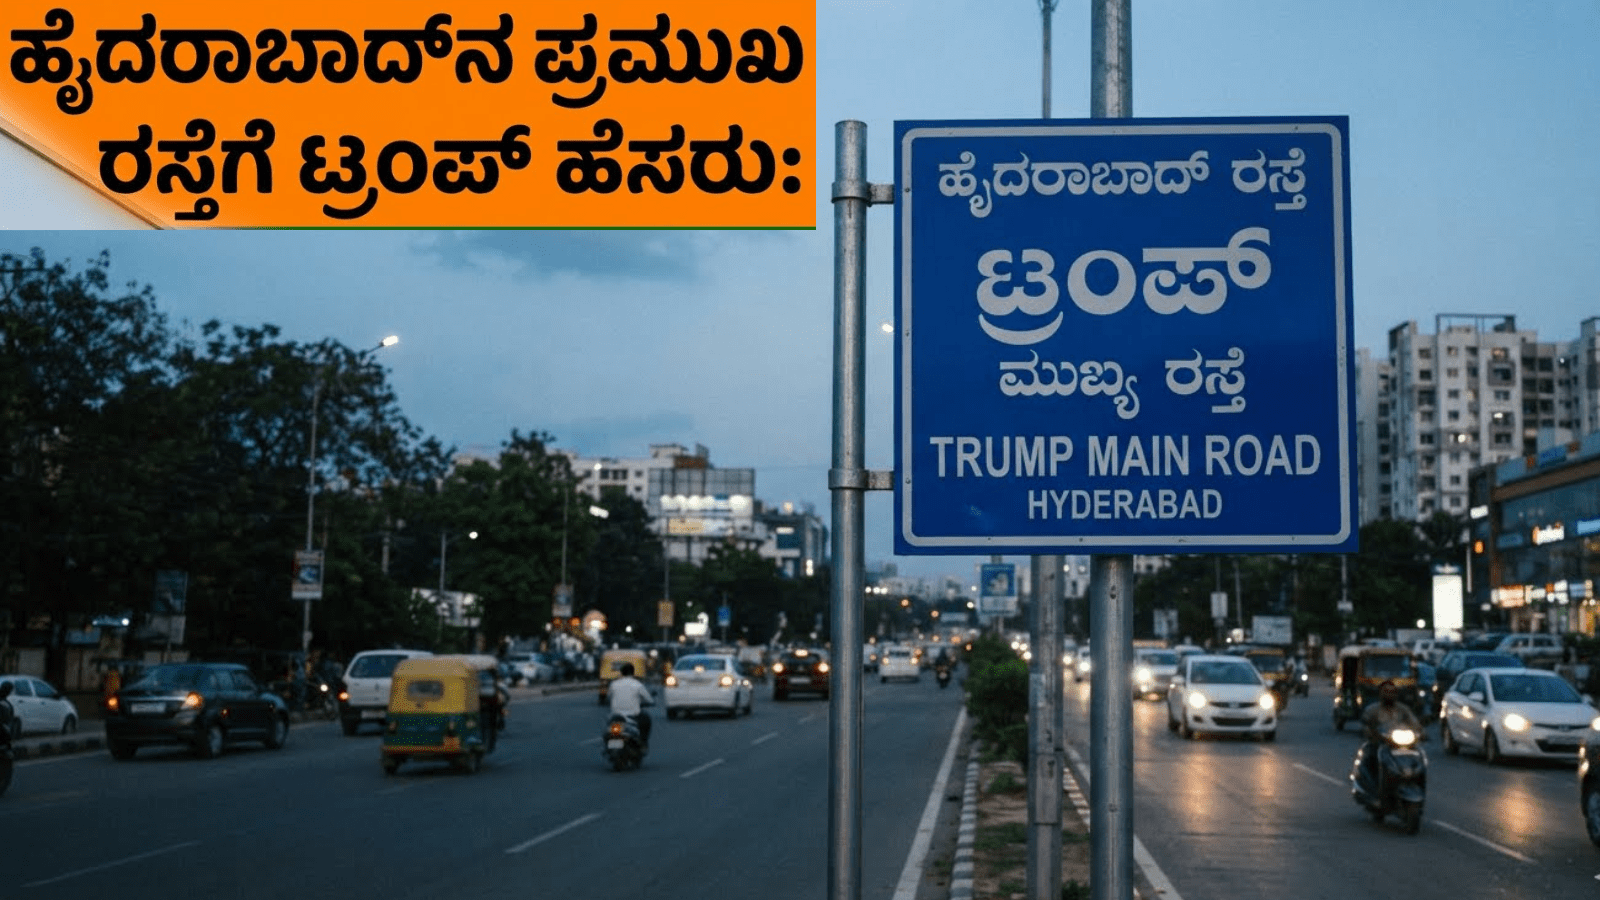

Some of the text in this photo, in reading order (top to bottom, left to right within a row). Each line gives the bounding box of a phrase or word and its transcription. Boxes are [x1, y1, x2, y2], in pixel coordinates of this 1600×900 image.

[938, 147, 1307, 218] ಹೈದರಾಬಾದ್ ರಸ್ತೆ
[976, 227, 1272, 345] ಟ್ರಂಪ್
[1164, 347, 1246, 413] ರಸ್ತೆ
[930, 434, 1321, 478] TRUMP MAIN ROAD
[1028, 489, 1222, 519] HYDERABAD
